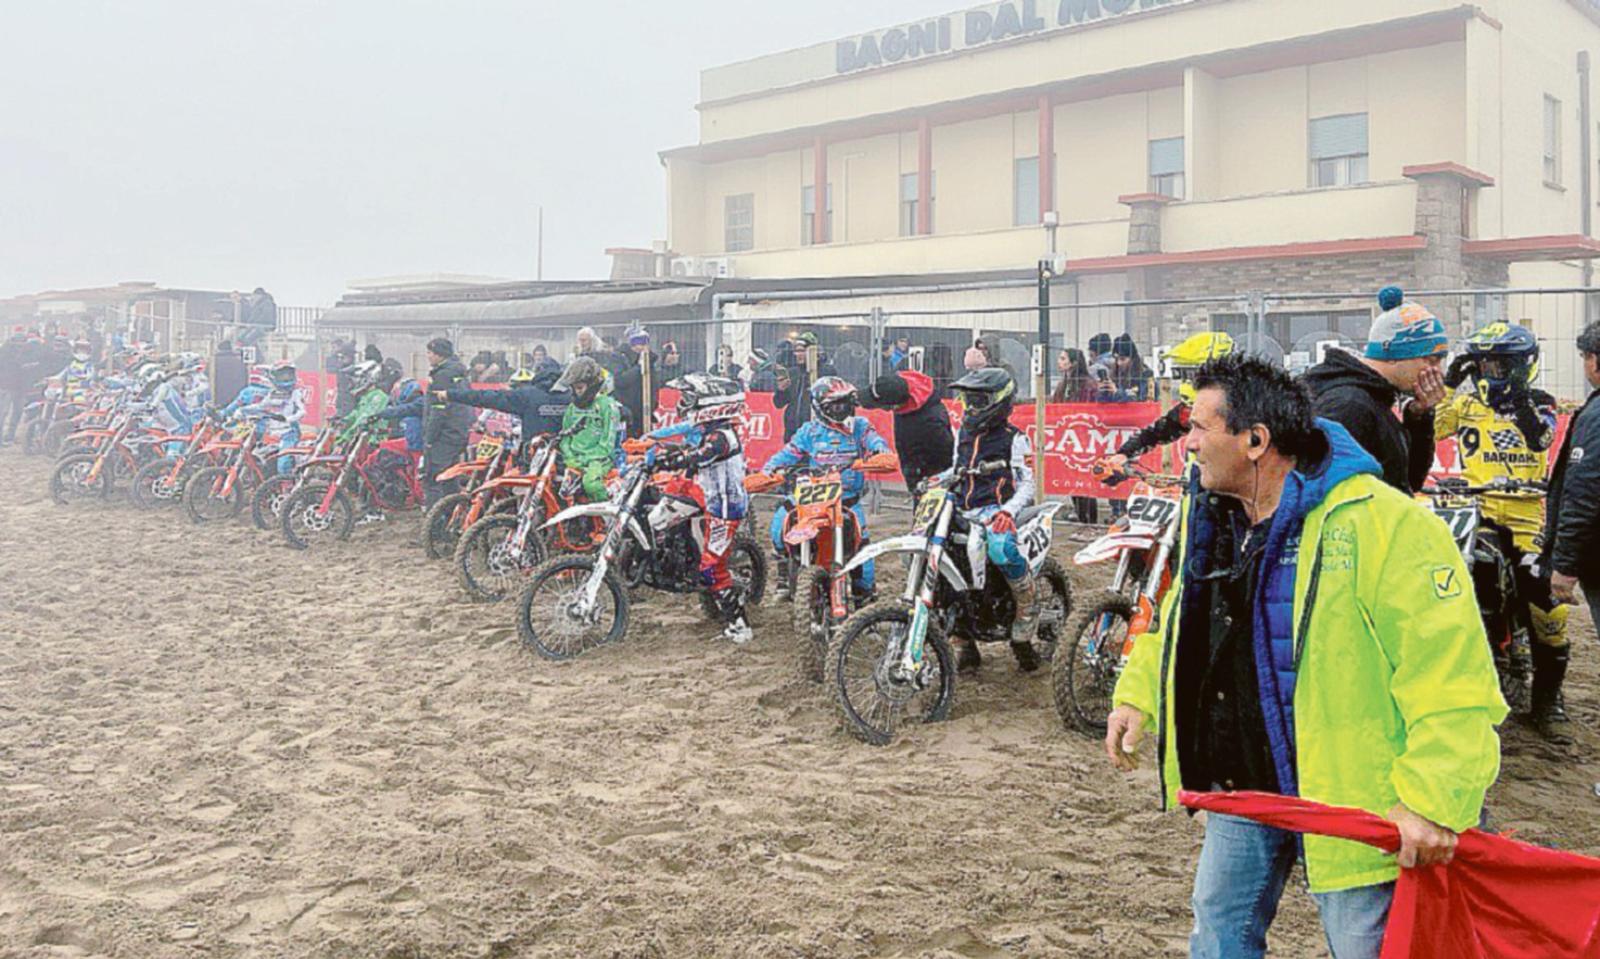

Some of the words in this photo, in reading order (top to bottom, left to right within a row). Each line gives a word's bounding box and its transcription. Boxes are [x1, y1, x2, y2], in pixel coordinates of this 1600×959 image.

[836, 17, 951, 74] BAGNI
[964, 0, 1045, 46] DAL
[799, 482, 841, 505] 227
[1128, 497, 1176, 526] 201
[1024, 525, 1049, 560] 213
